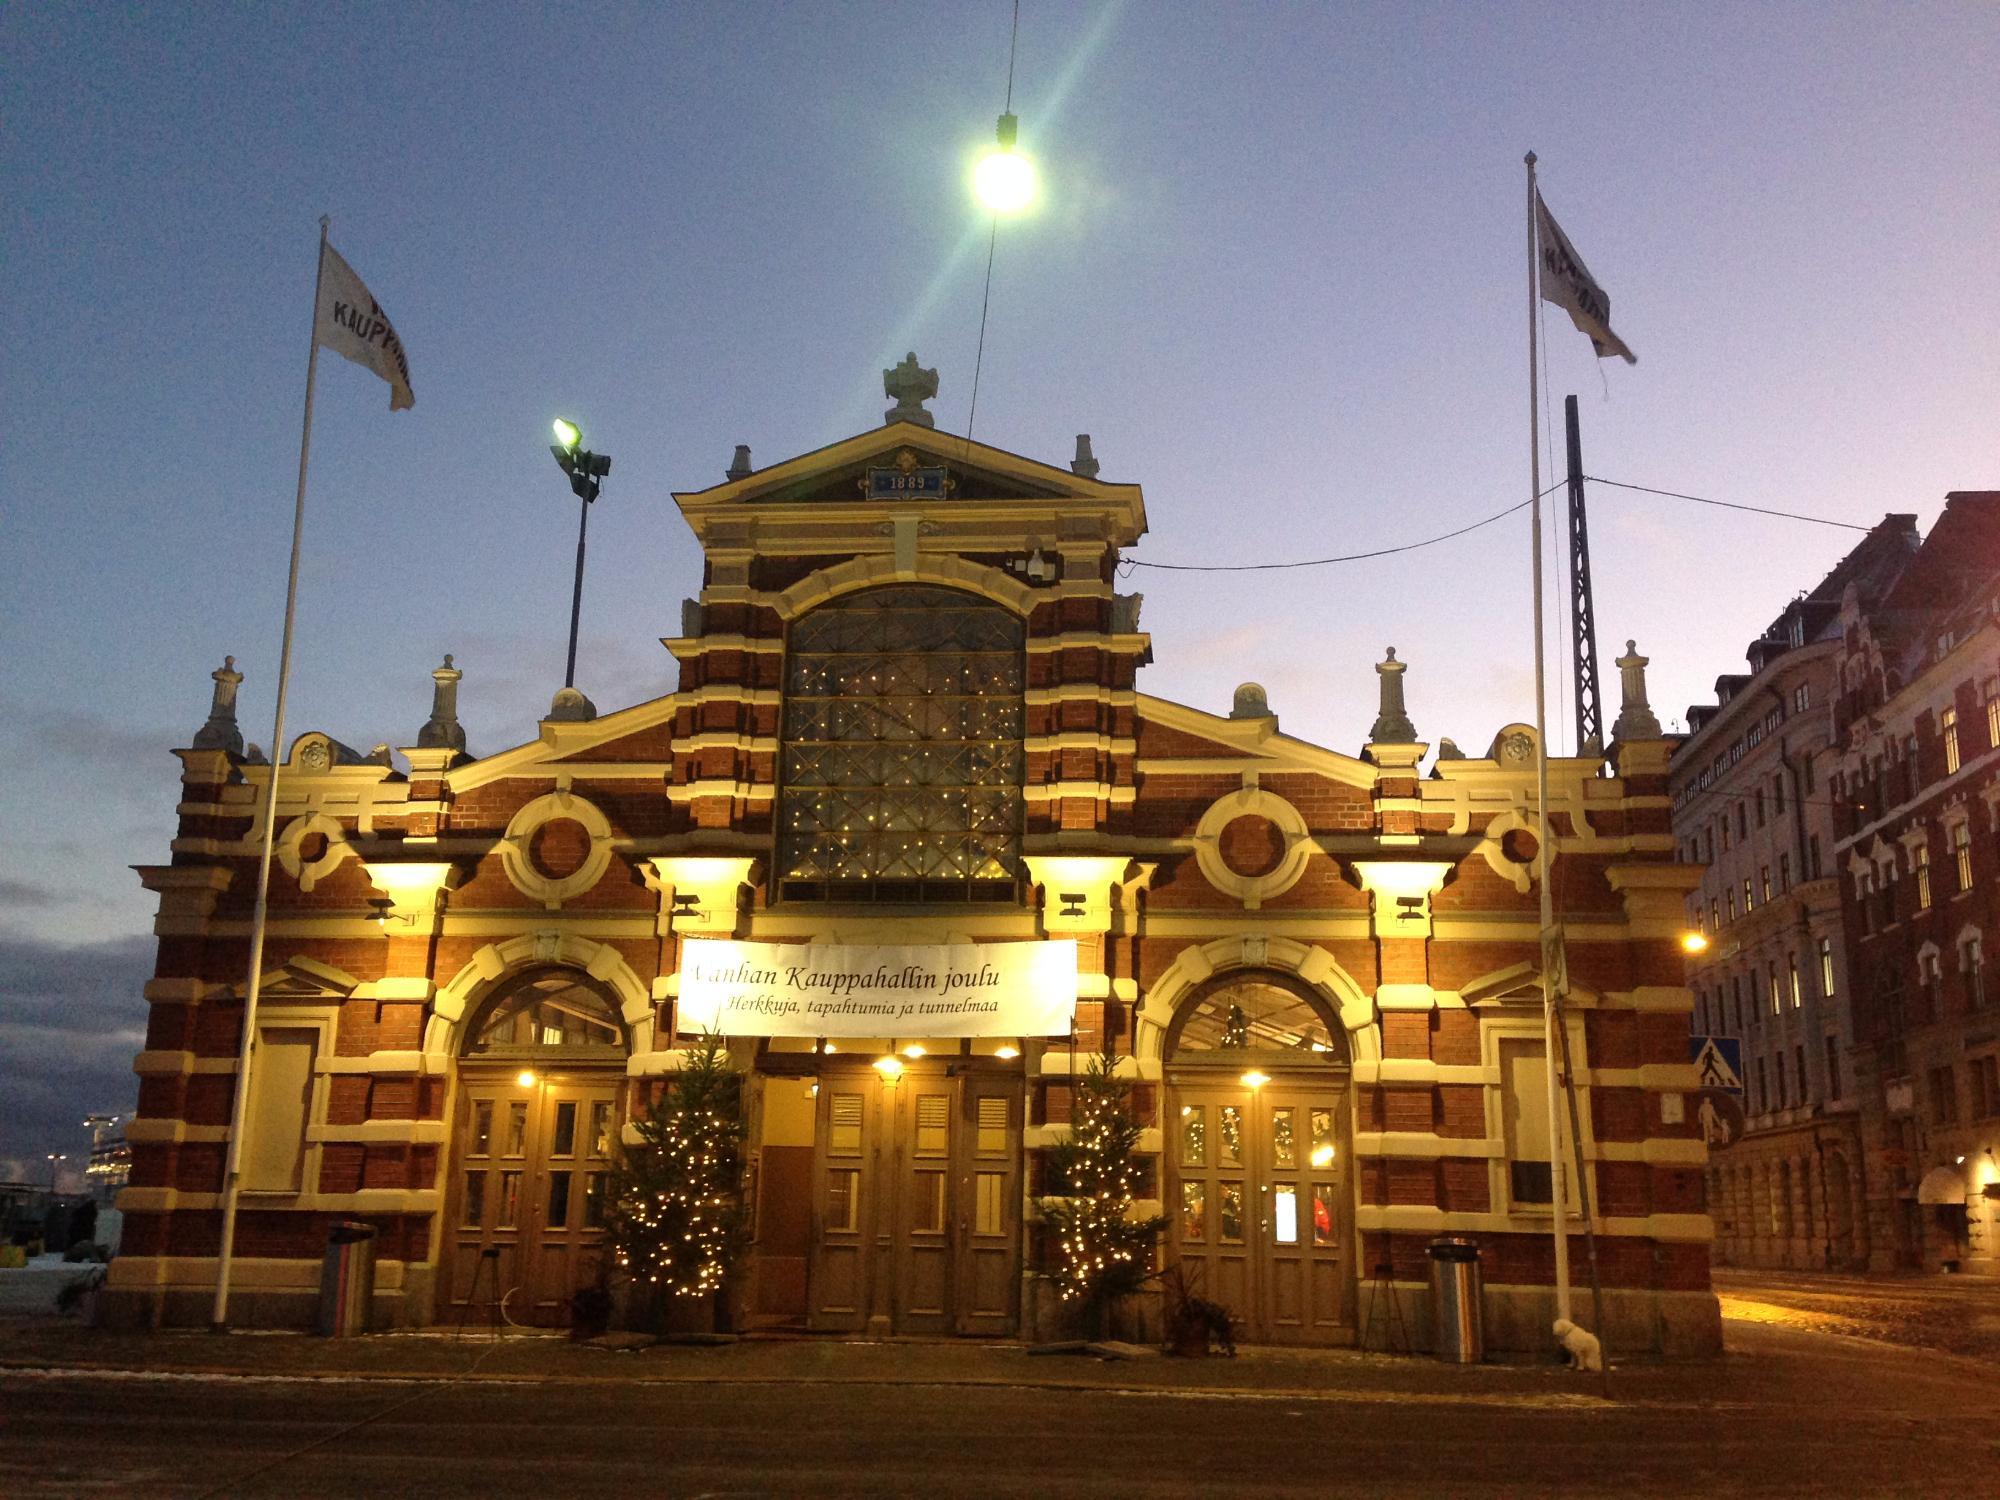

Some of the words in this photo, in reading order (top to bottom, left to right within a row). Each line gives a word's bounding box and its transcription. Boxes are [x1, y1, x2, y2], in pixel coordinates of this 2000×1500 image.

[890, 476, 925, 489] 1889
[785, 964, 937, 996] Kauppahallin
[938, 963, 1000, 996] joulu
[726, 994, 801, 1017] Herkkuja,
[807, 997, 896, 1018] tapahtumia
[895, 1001, 914, 1019] ja
[918, 997, 999, 1014] tunnelmaa
